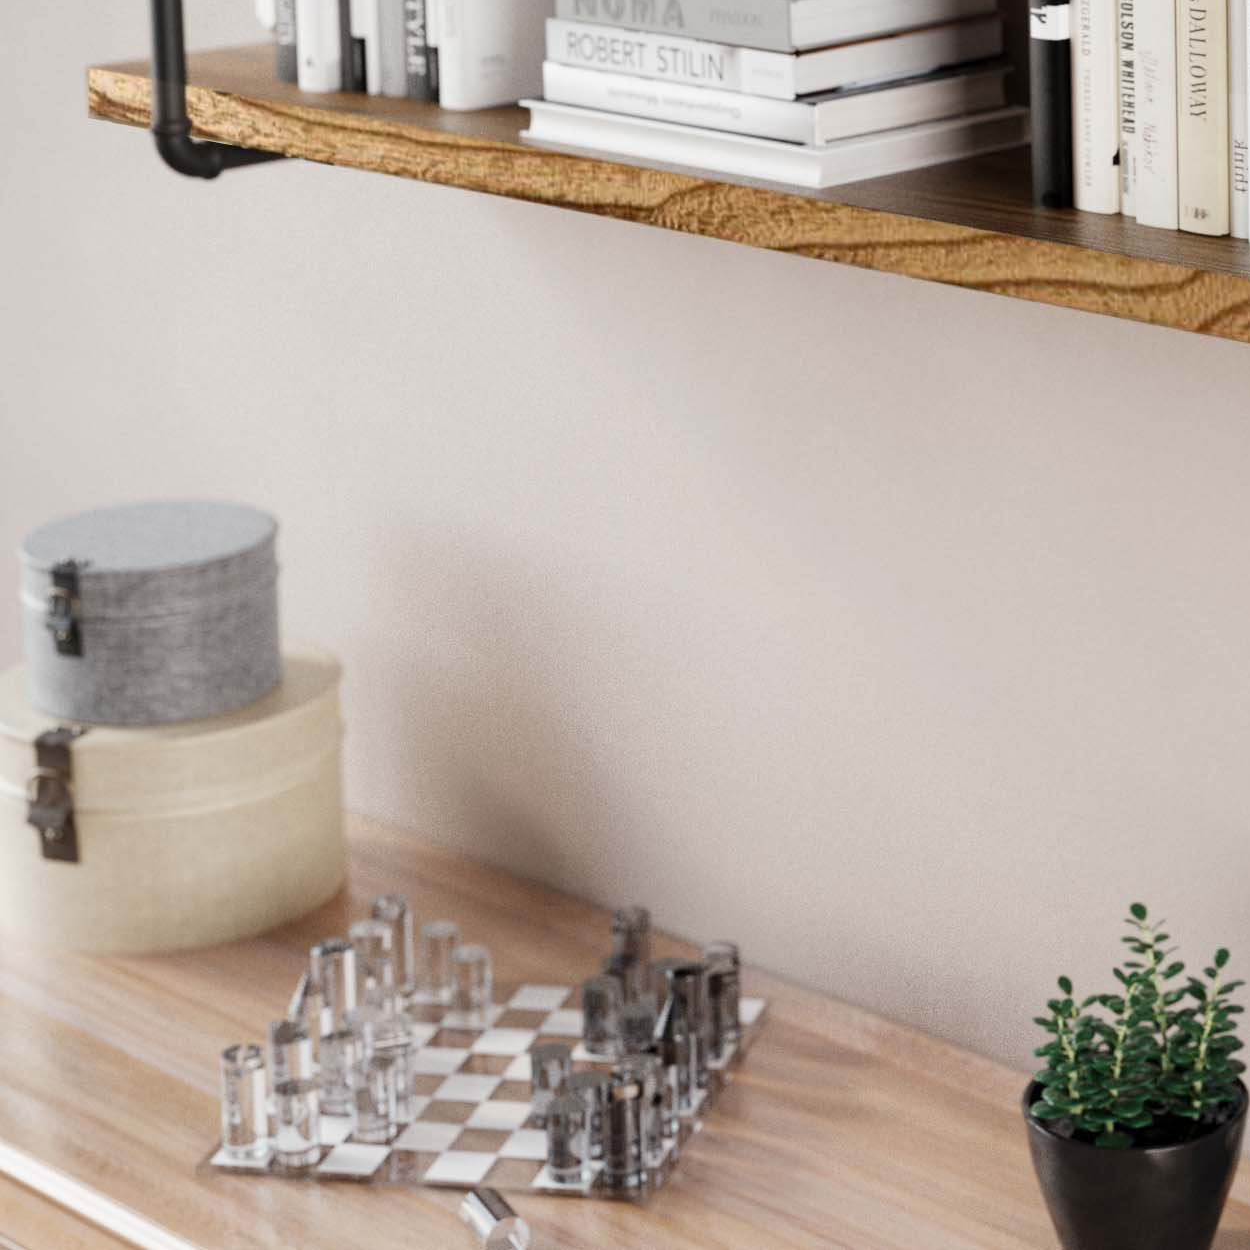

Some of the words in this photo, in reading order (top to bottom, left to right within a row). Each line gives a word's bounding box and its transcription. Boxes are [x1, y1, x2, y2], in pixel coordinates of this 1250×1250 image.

[566, 31, 648, 69] ROBERT
[656, 45, 725, 82] STILIN
[1189, 7, 1207, 122] DALLOWAY
[1121, 59, 1137, 135] WHITEHEAD
